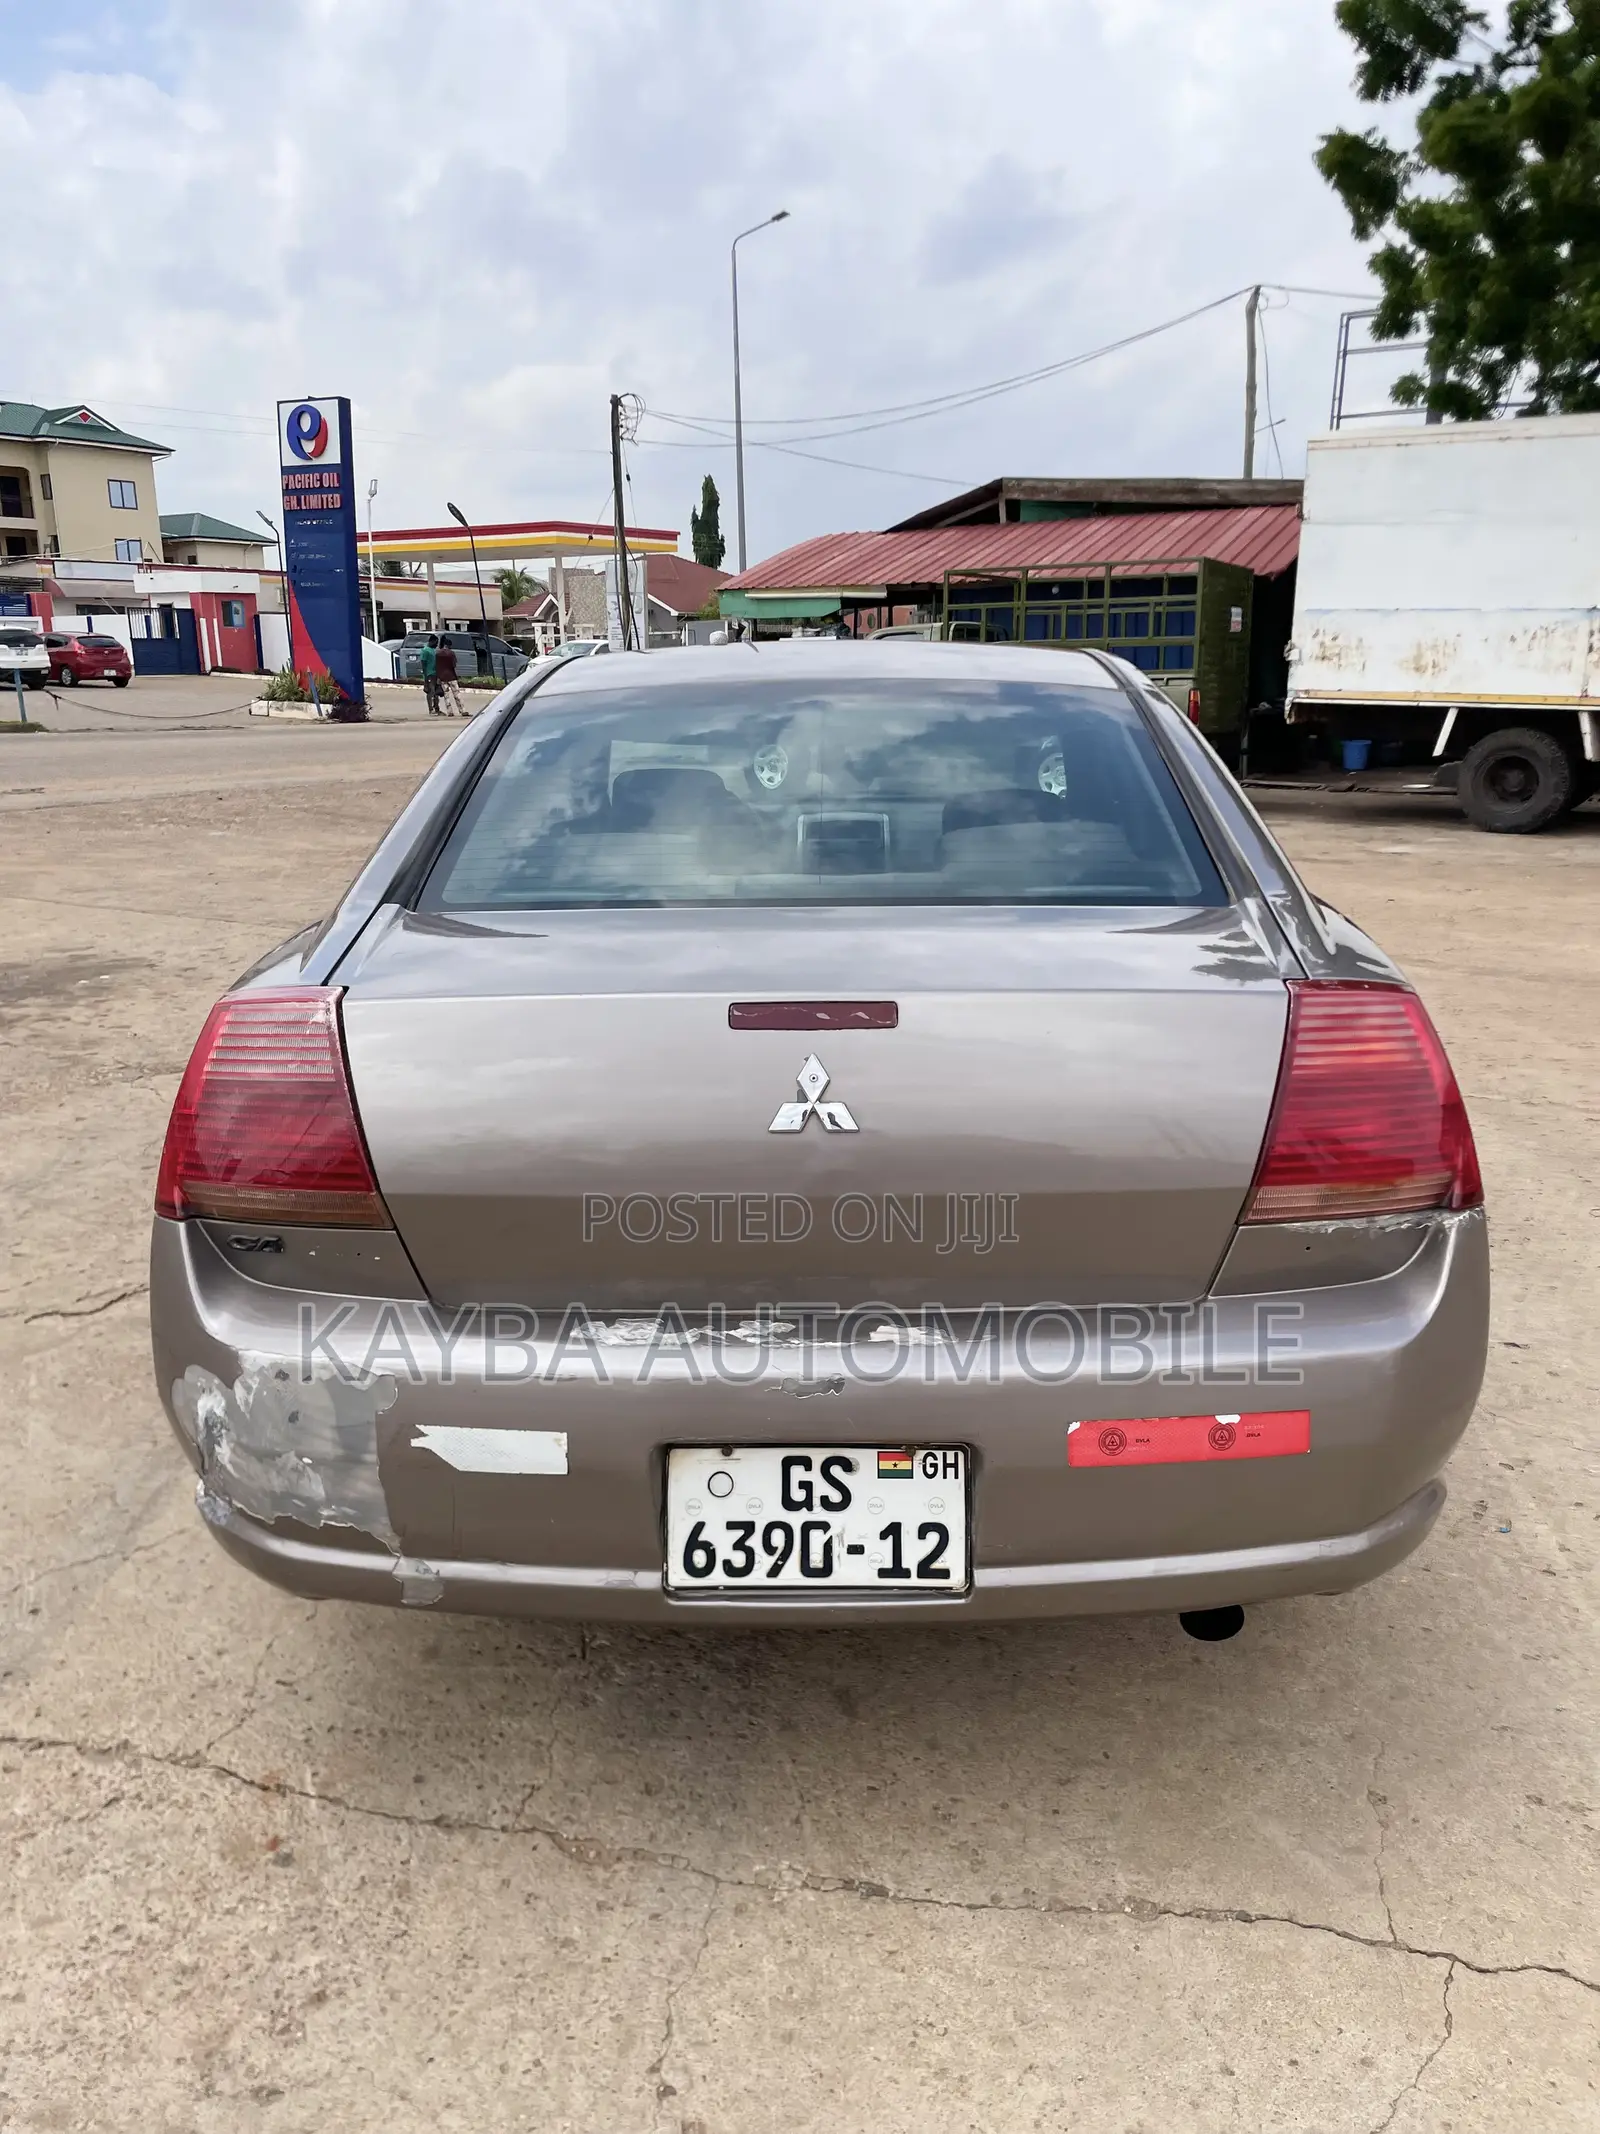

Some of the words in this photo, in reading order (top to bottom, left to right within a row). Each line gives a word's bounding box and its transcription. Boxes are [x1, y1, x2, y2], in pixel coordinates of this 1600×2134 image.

[282, 473, 320, 490] PACIFIC
[322, 472, 340, 488] OIL
[284, 495, 300, 510] GH.
[301, 493, 341, 510] LIMITED
[921, 1451, 960, 1480] GH
[781, 1455, 852, 1512] GS
[683, 1520, 951, 1579] 6390-12
